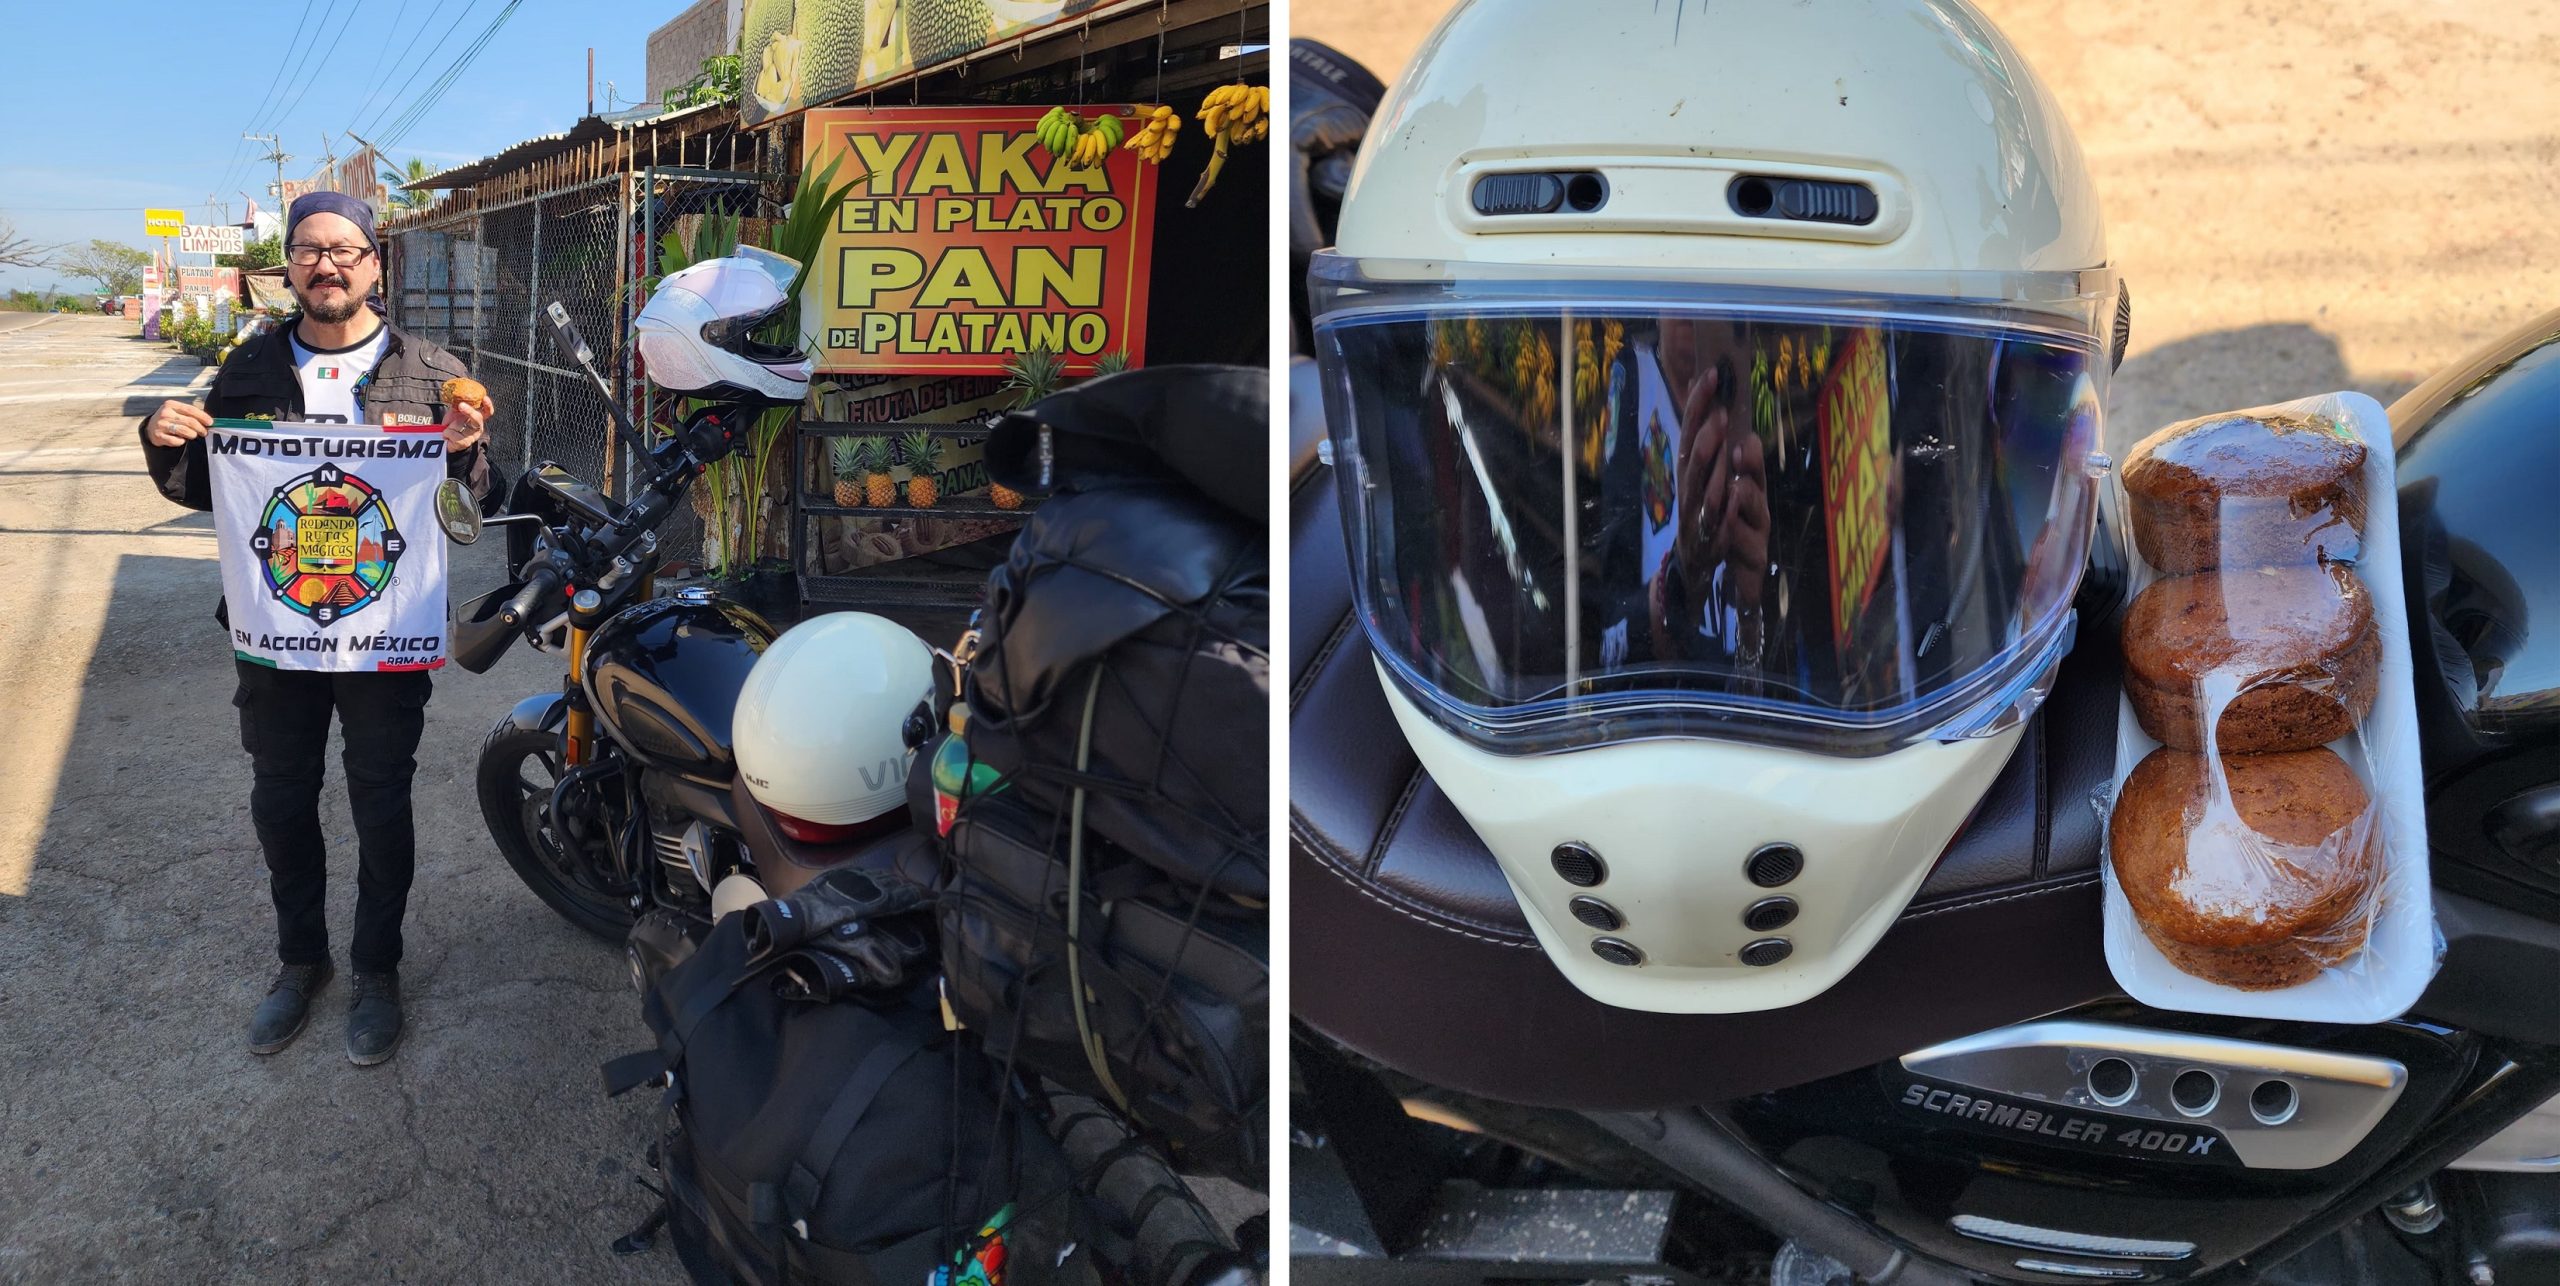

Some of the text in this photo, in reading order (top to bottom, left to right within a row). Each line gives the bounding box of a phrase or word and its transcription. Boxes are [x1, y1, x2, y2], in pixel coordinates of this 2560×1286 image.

[845, 132, 1114, 197] YAKA
[838, 197, 1127, 232] EN PLATO
[182, 239, 243, 252] LIMPIOS
[838, 246, 1108, 309] PAN
[829, 312, 1109, 355] DE PLATANO
[849, 390, 918, 423] FRUTA
[918, 375, 947, 413] DE
[211, 434, 446, 459] MOTOTURISMO
[321, 470, 337, 482] N
[387, 540, 400, 551] E
[318, 608, 332, 620] S
[235, 629, 440, 652] EN ACCIÓN MÉXICO
[1901, 1084, 2108, 1143] SCRAMBLER
